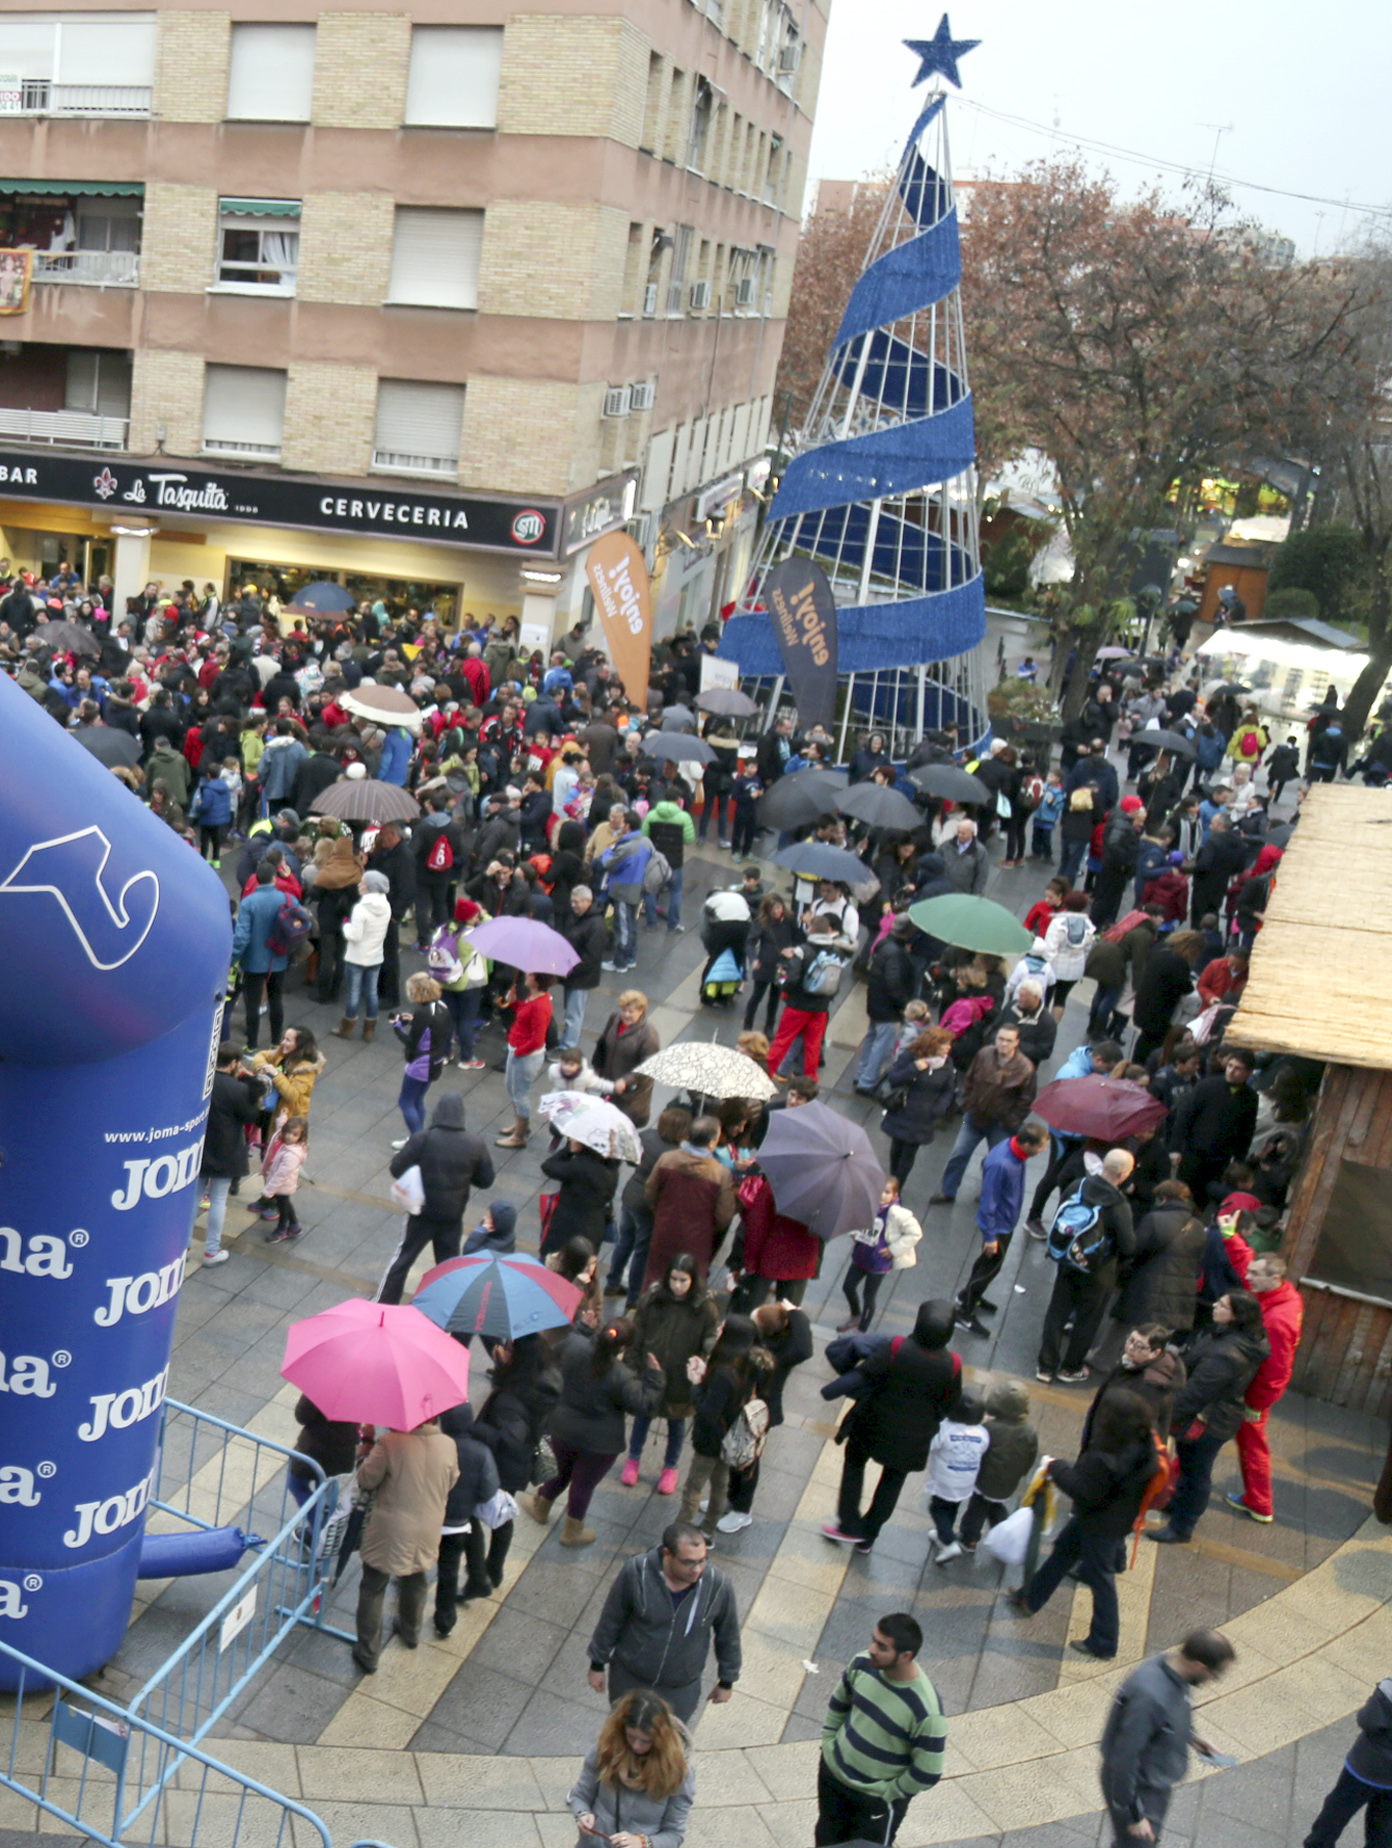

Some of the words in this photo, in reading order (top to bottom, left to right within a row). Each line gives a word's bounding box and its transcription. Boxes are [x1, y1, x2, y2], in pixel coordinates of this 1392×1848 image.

[123, 479, 147, 504] La
[148, 473, 229, 511] Tasquita
[320, 497, 469, 529] CERVECERIA
